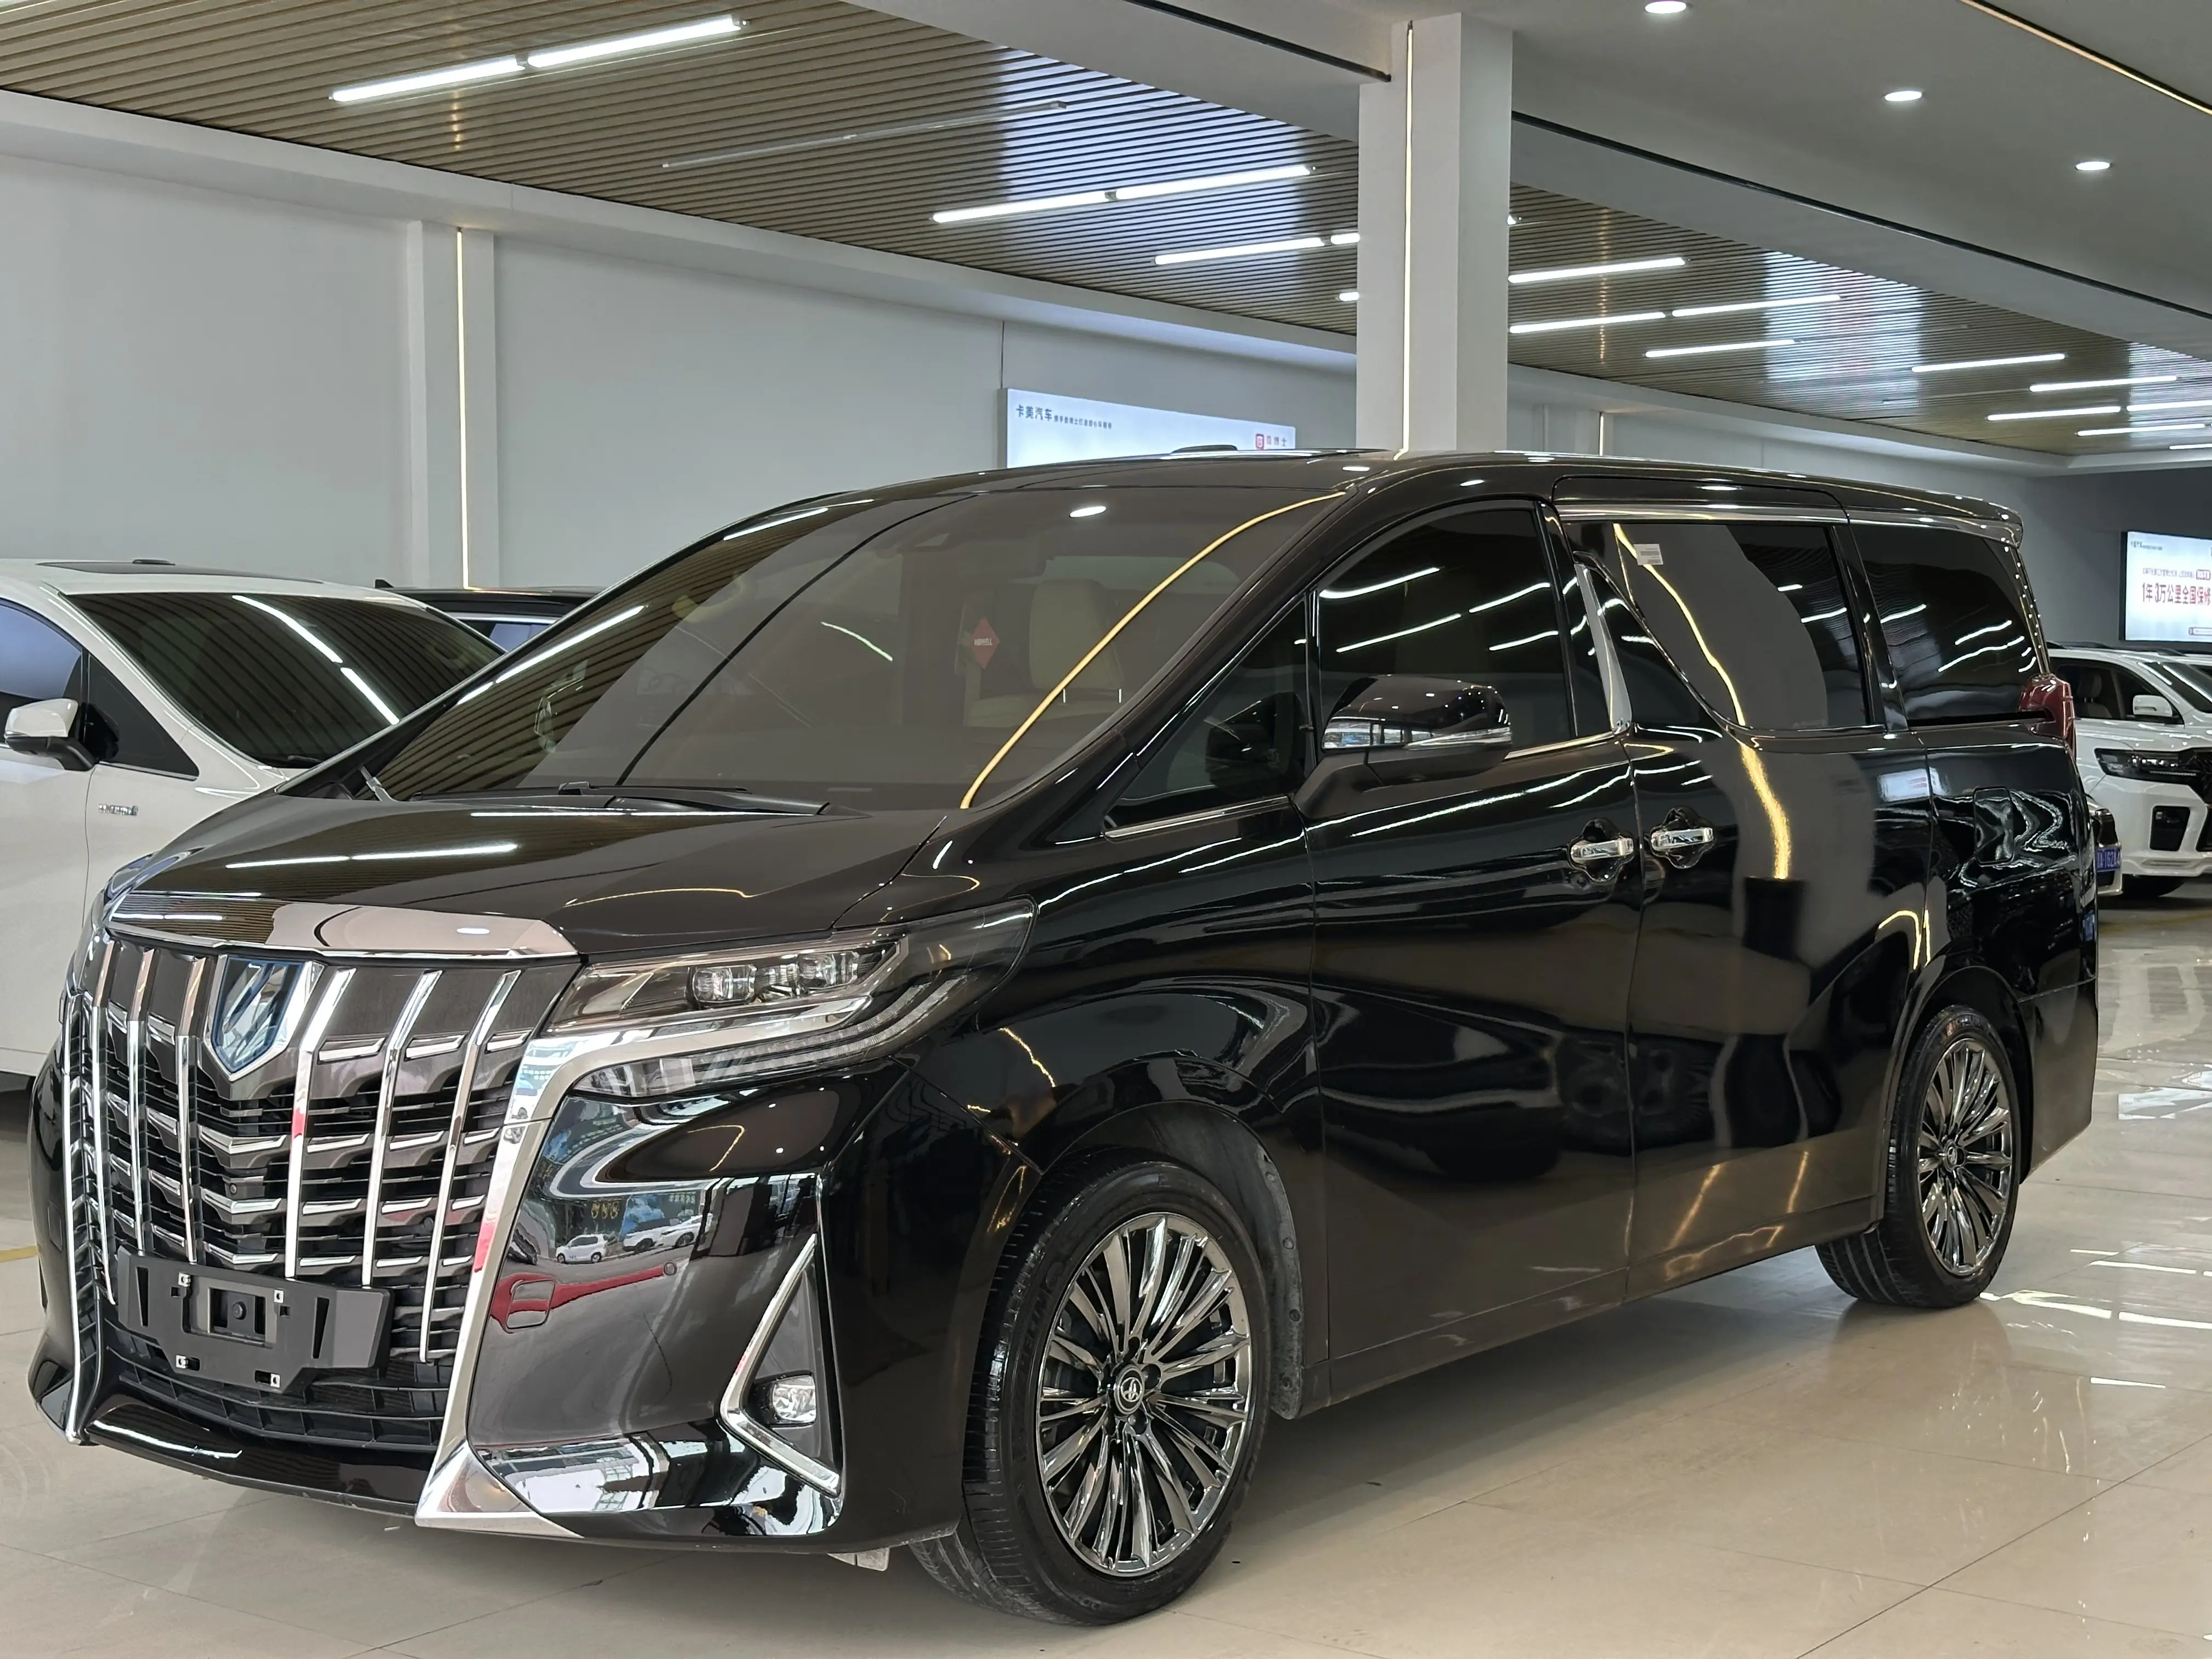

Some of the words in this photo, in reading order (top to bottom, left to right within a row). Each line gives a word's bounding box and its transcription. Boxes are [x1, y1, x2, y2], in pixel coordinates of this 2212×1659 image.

[2142, 582, 2211, 606] 1年3万公里全国保修
